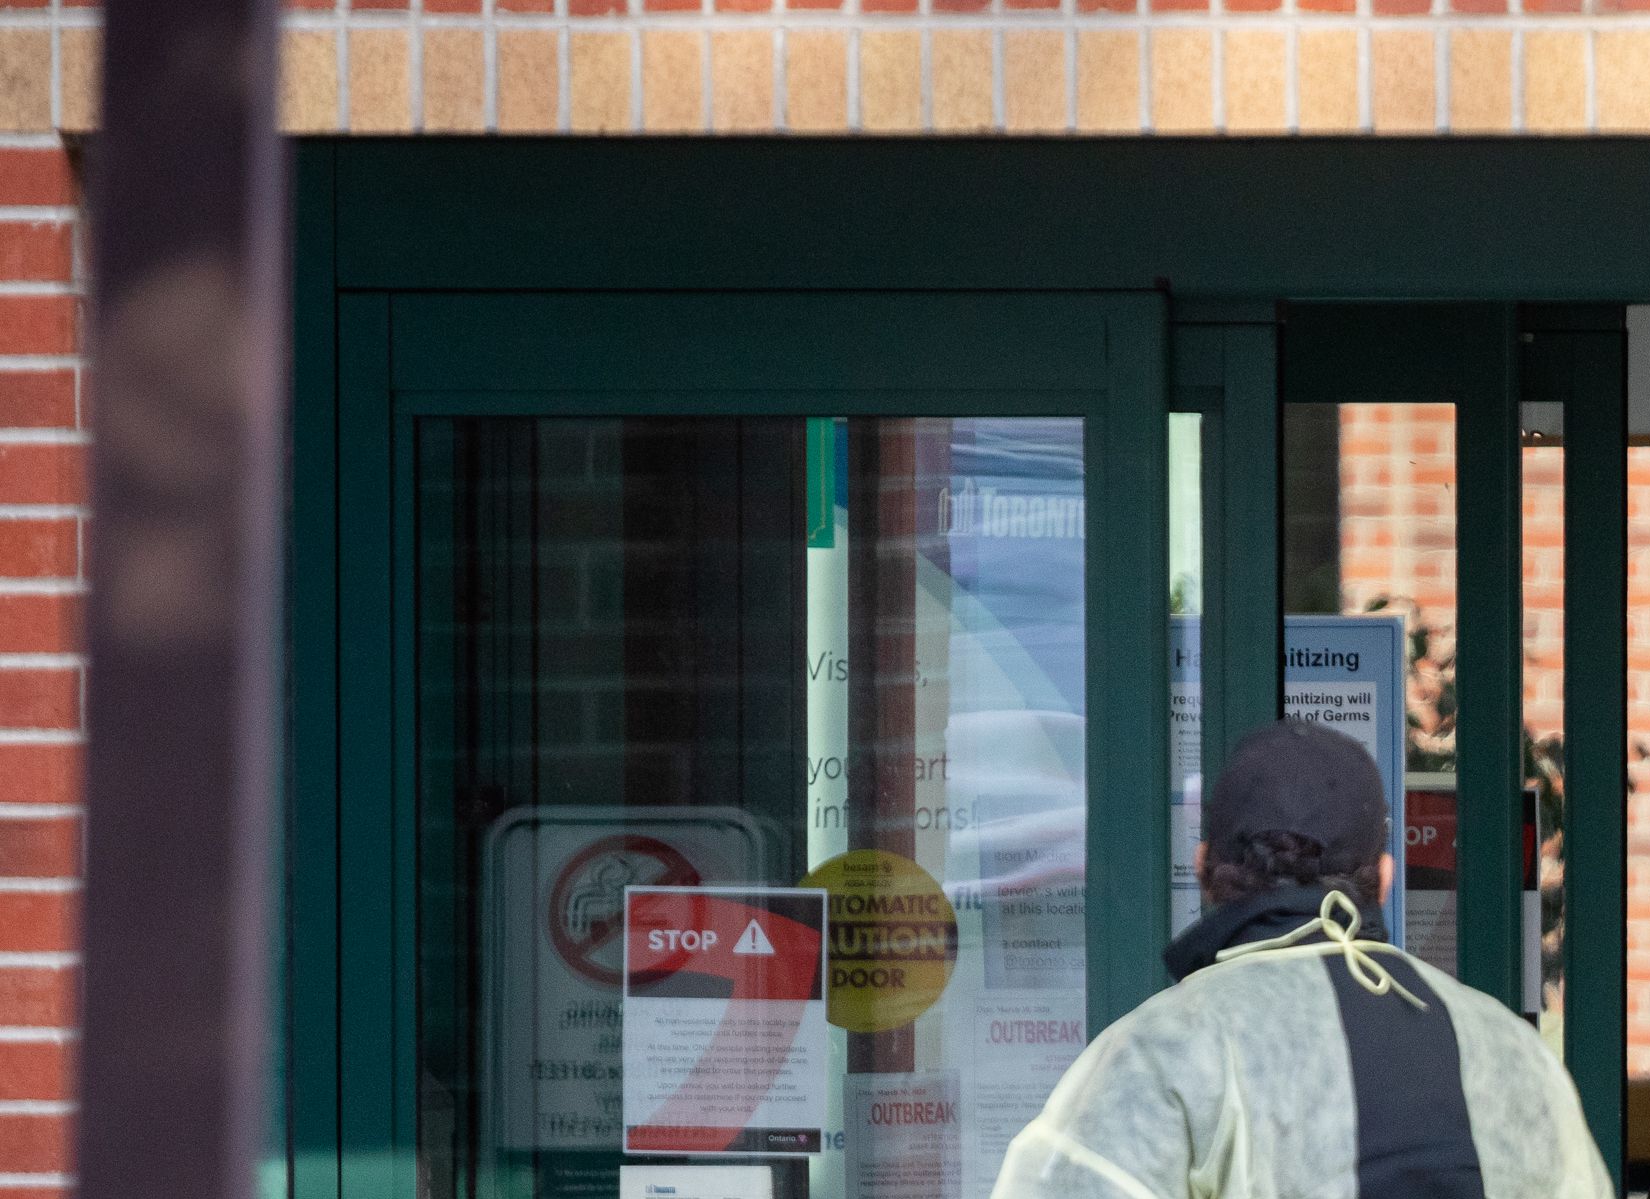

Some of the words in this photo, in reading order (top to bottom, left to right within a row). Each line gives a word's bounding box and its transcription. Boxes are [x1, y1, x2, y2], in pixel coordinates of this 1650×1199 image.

[1284, 693, 1343, 707] anitizing
[1348, 693, 1371, 705] will
[1307, 709, 1320, 722] of
[1323, 709, 1370, 722] Germs
[1405, 826, 1437, 845] OP
[830, 894, 939, 915] TOMATIC
[1019, 902, 1041, 914] this
[648, 929, 718, 951] STOP
[830, 926, 946, 955] UTION
[832, 968, 905, 988] DOOR
[990, 1019, 1082, 1044] OUTBREAK
[870, 1101, 957, 1126] OUTBREAK
[768, 1134, 796, 1143] Ontario
